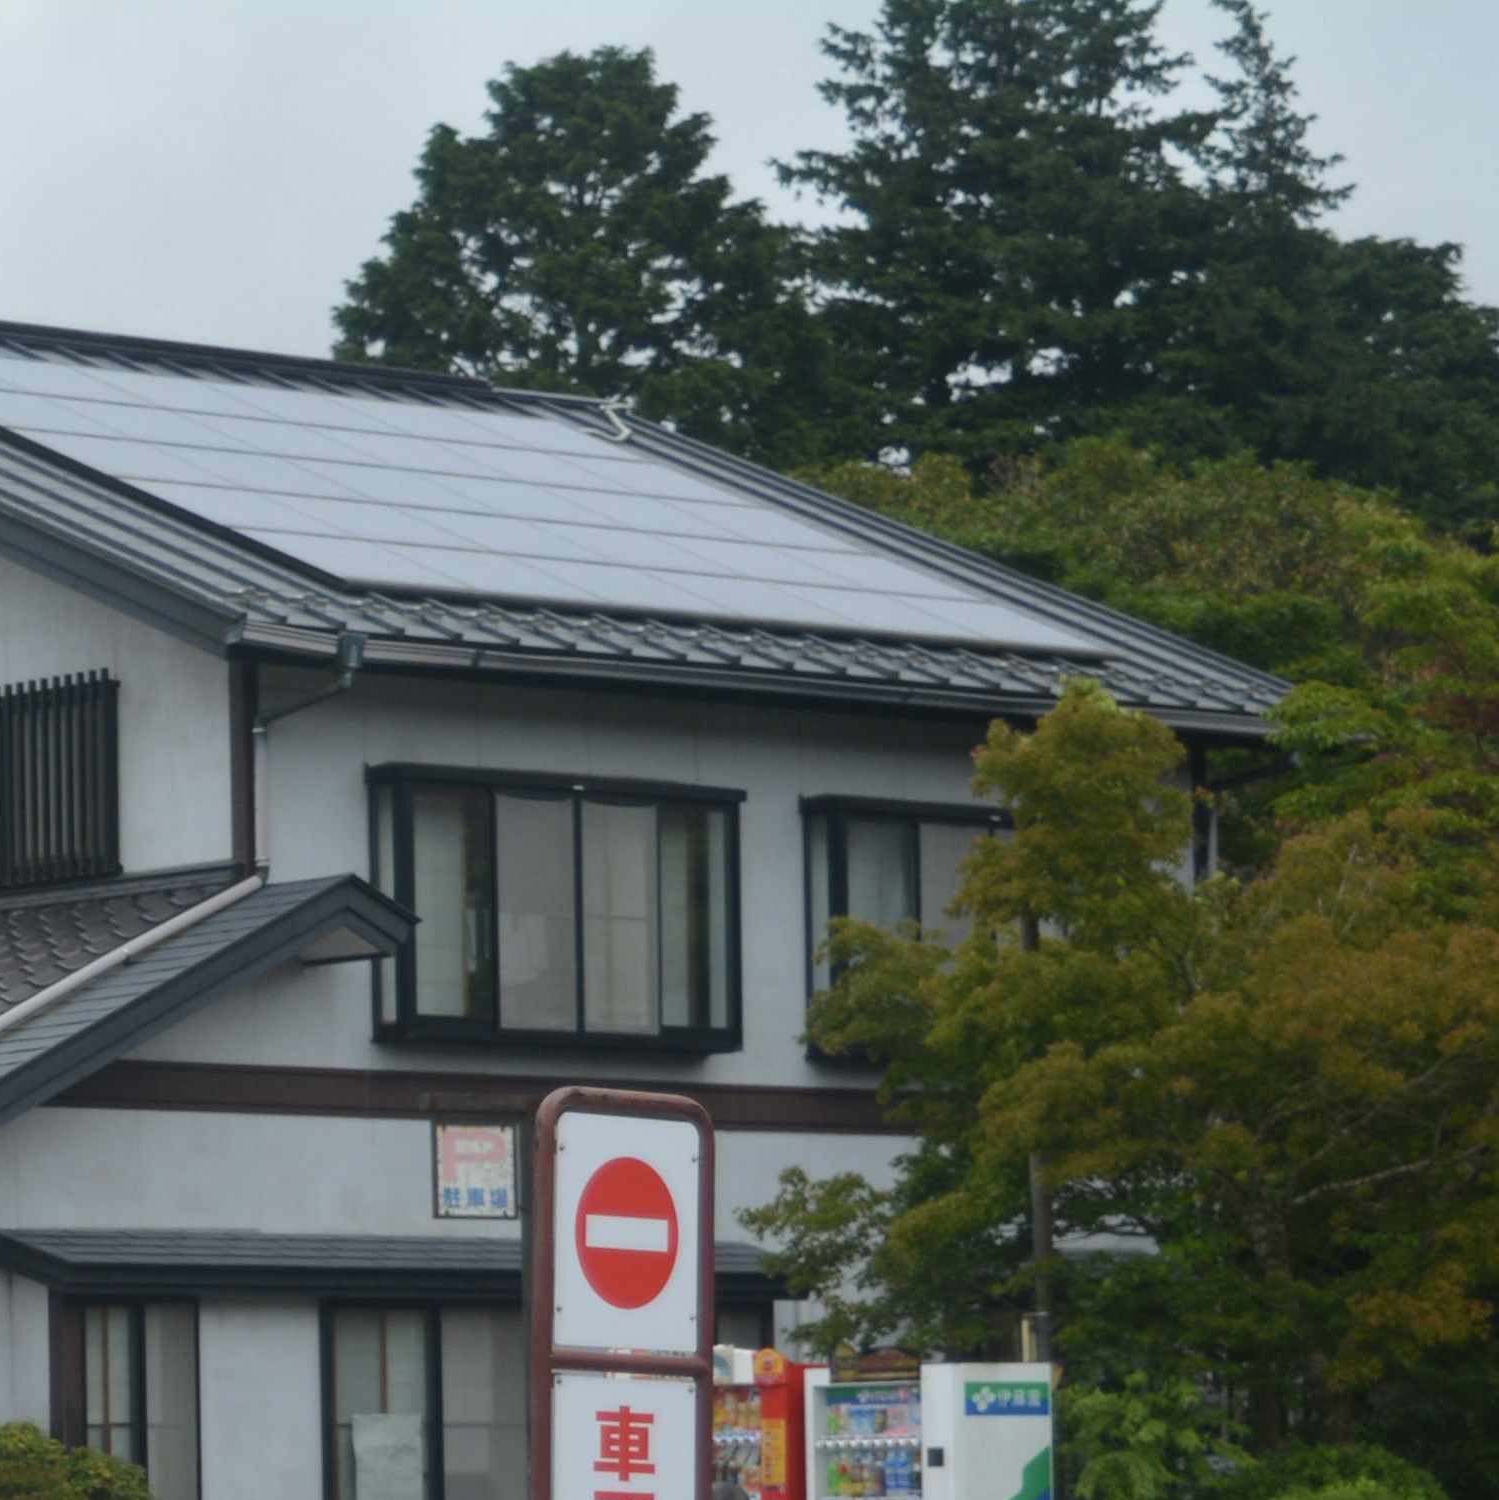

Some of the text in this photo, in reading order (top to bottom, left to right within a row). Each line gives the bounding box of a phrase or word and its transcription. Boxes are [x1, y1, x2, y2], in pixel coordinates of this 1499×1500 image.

[443, 1130, 506, 1183] P
[443, 1187, 507, 1208] 駐車場
